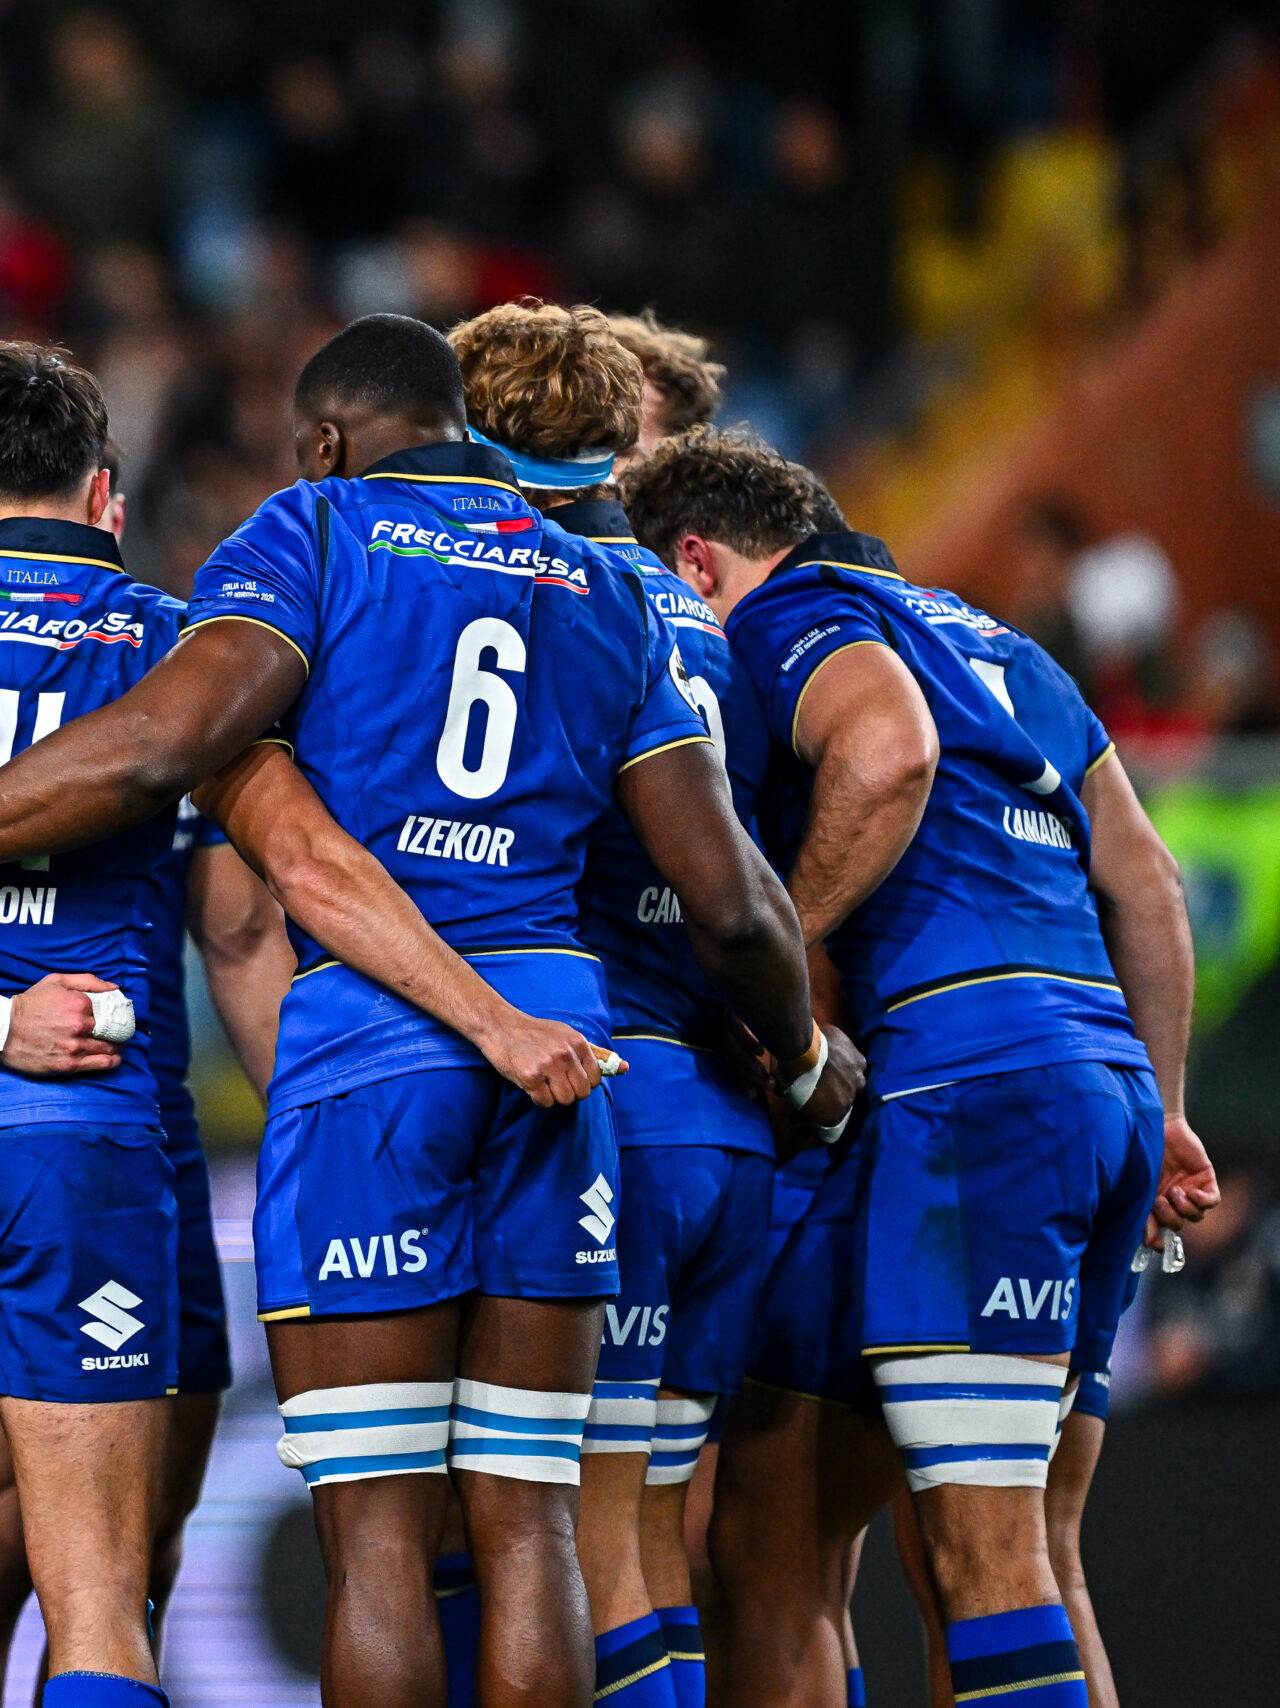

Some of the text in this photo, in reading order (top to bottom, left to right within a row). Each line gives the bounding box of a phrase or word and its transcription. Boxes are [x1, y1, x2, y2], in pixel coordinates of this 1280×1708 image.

[452, 496, 502, 511] ITALIA
[7, 569, 59, 585] ITALIA
[436, 617, 527, 800] 6
[397, 815, 515, 867] IZEKOR
[318, 1228, 427, 1281] AVIS
[575, 1248, 617, 1264] SUZUK
[980, 1277, 1076, 1320] AVIS
[601, 1304, 670, 1346] VIS
[81, 1352, 150, 1371] SUZUKI
